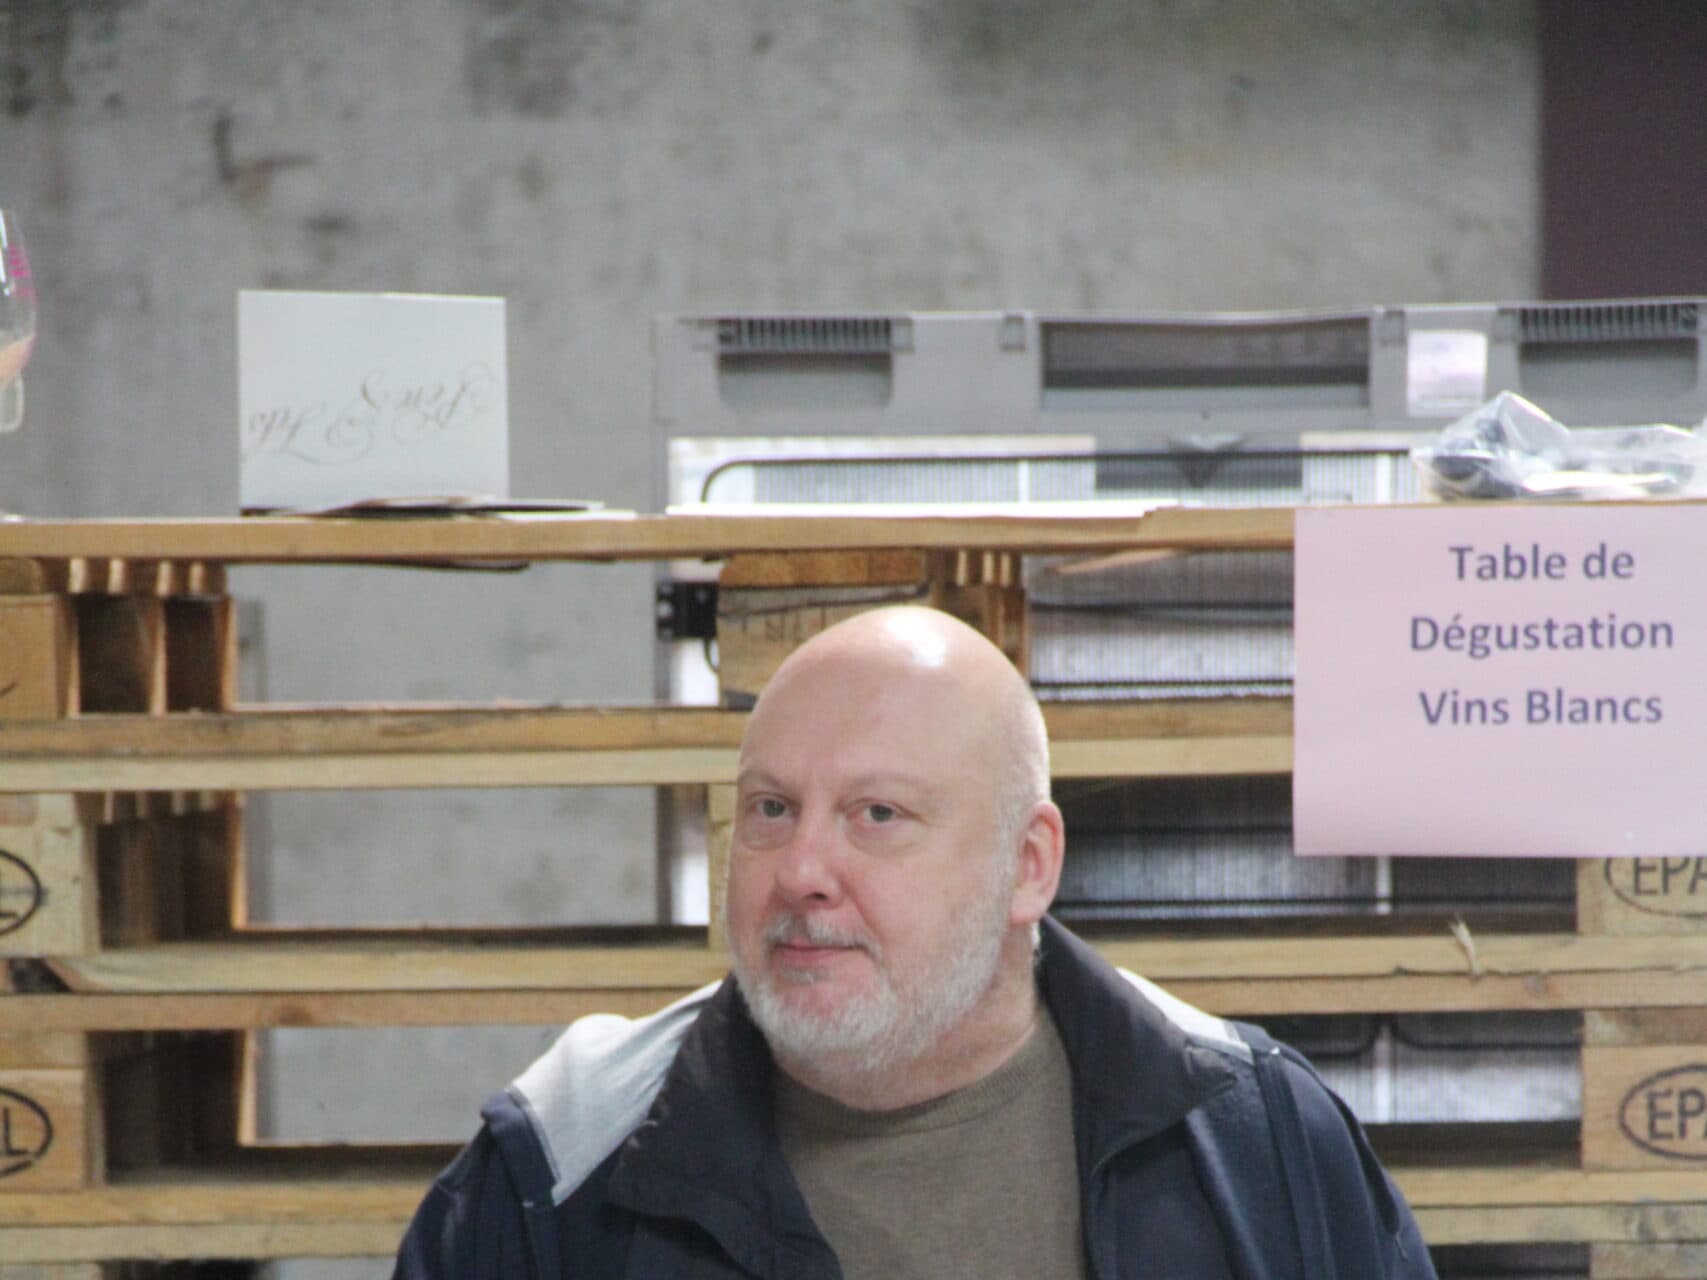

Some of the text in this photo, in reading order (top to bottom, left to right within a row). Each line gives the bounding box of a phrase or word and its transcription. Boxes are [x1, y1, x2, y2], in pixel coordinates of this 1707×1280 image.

[1448, 543, 1635, 580] Table de
[1410, 614, 1674, 659] Dégustation
[1418, 687, 1664, 726] Vins Blancs
